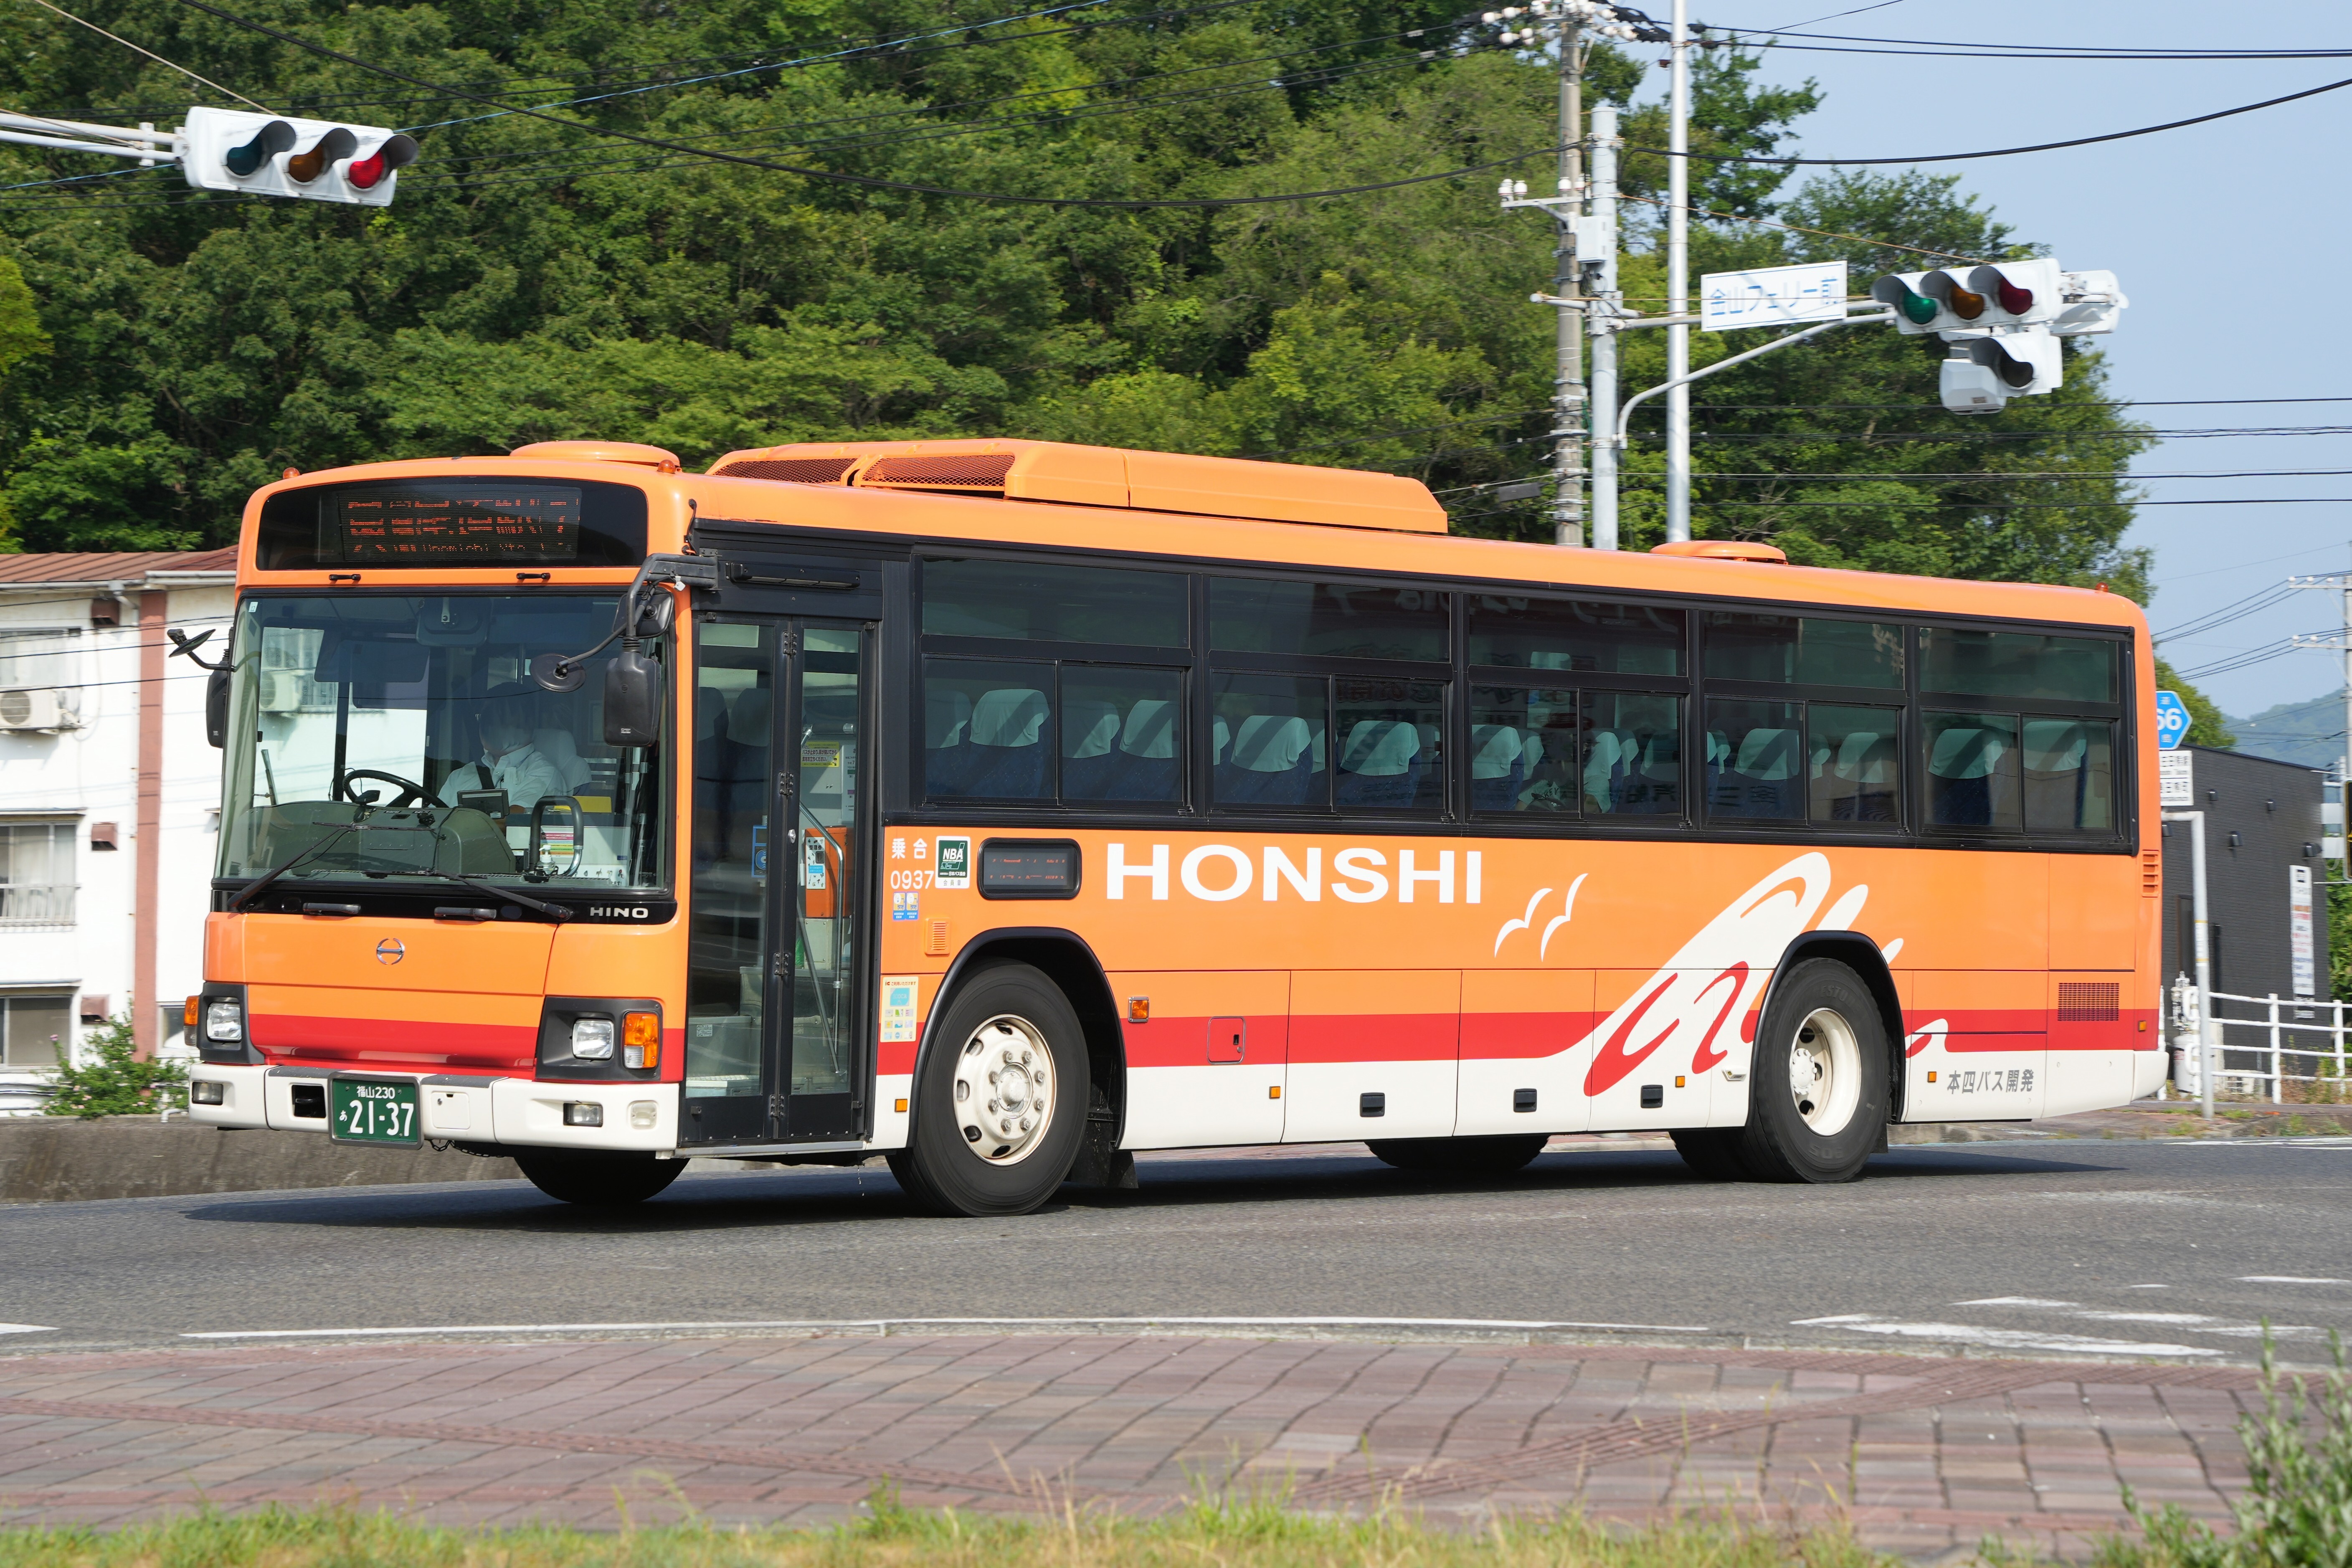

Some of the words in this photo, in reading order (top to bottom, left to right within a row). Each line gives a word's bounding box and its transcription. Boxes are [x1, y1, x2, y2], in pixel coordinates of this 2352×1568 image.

[1711, 276, 1838, 316] 金山フェリー前
[892, 838, 927, 859] 乗合
[943, 848, 963, 860] NBA
[890, 870, 934, 889] 0937
[1107, 843, 1481, 903] HONSHI
[590, 907, 648, 918] HINO
[1947, 1069, 2034, 1094] 本四バス開発
[339, 1110, 347, 1122] あ
[350, 1100, 414, 1137] 21-37
